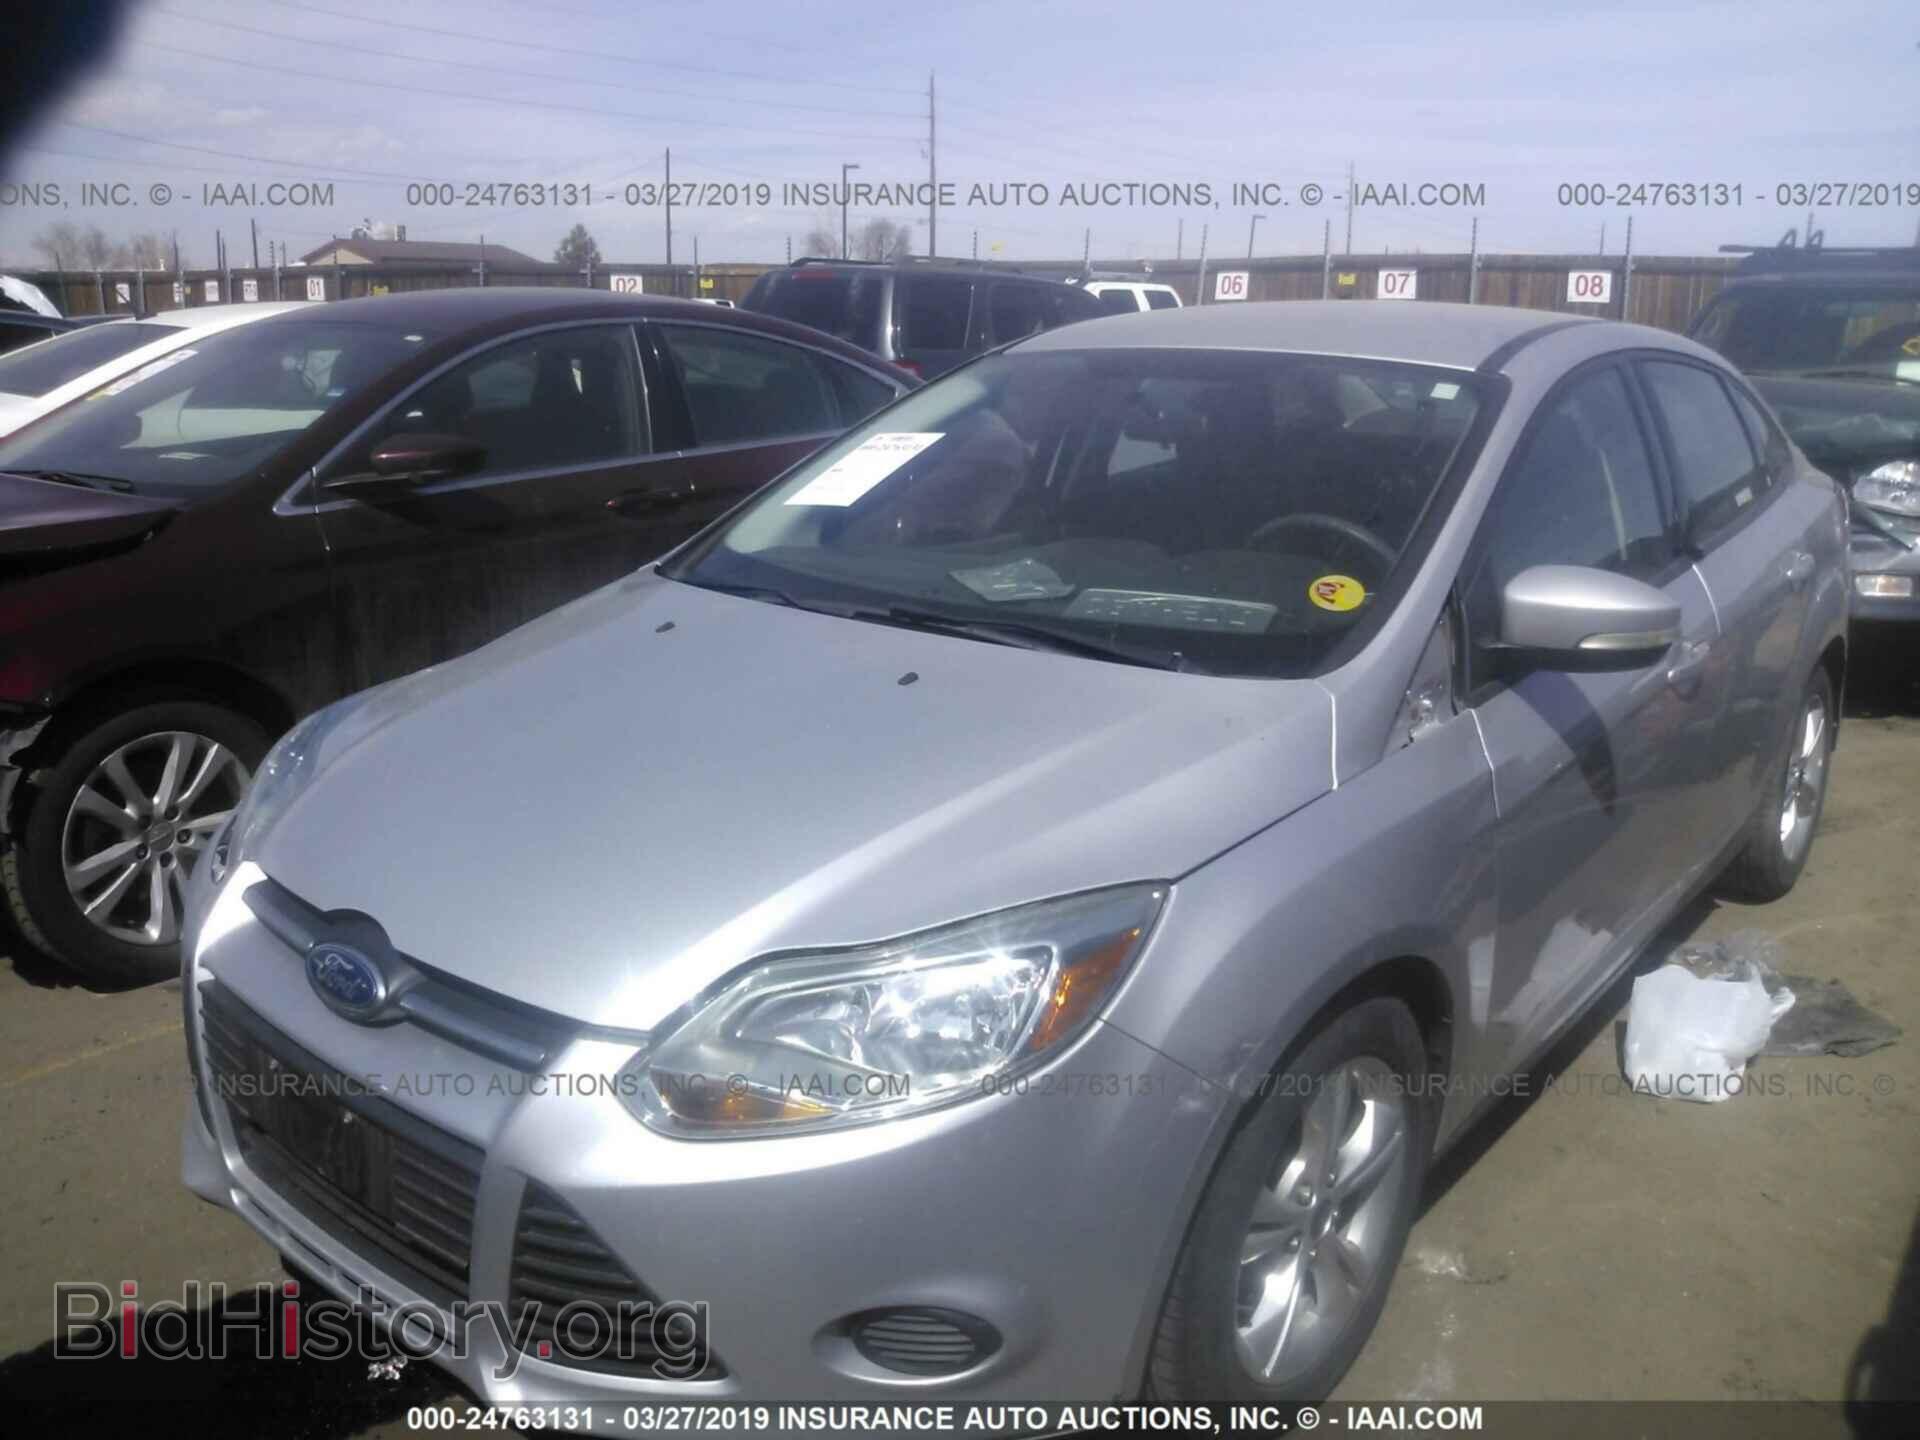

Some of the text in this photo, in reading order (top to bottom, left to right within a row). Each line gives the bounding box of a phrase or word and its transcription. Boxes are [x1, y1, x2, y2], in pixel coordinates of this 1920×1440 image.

[309, 278, 322, 298] 01
[615, 277, 638, 295] 02
[1220, 275, 1243, 295] 06
[1383, 272, 1410, 294] 07
[1575, 274, 1603, 297] 08
